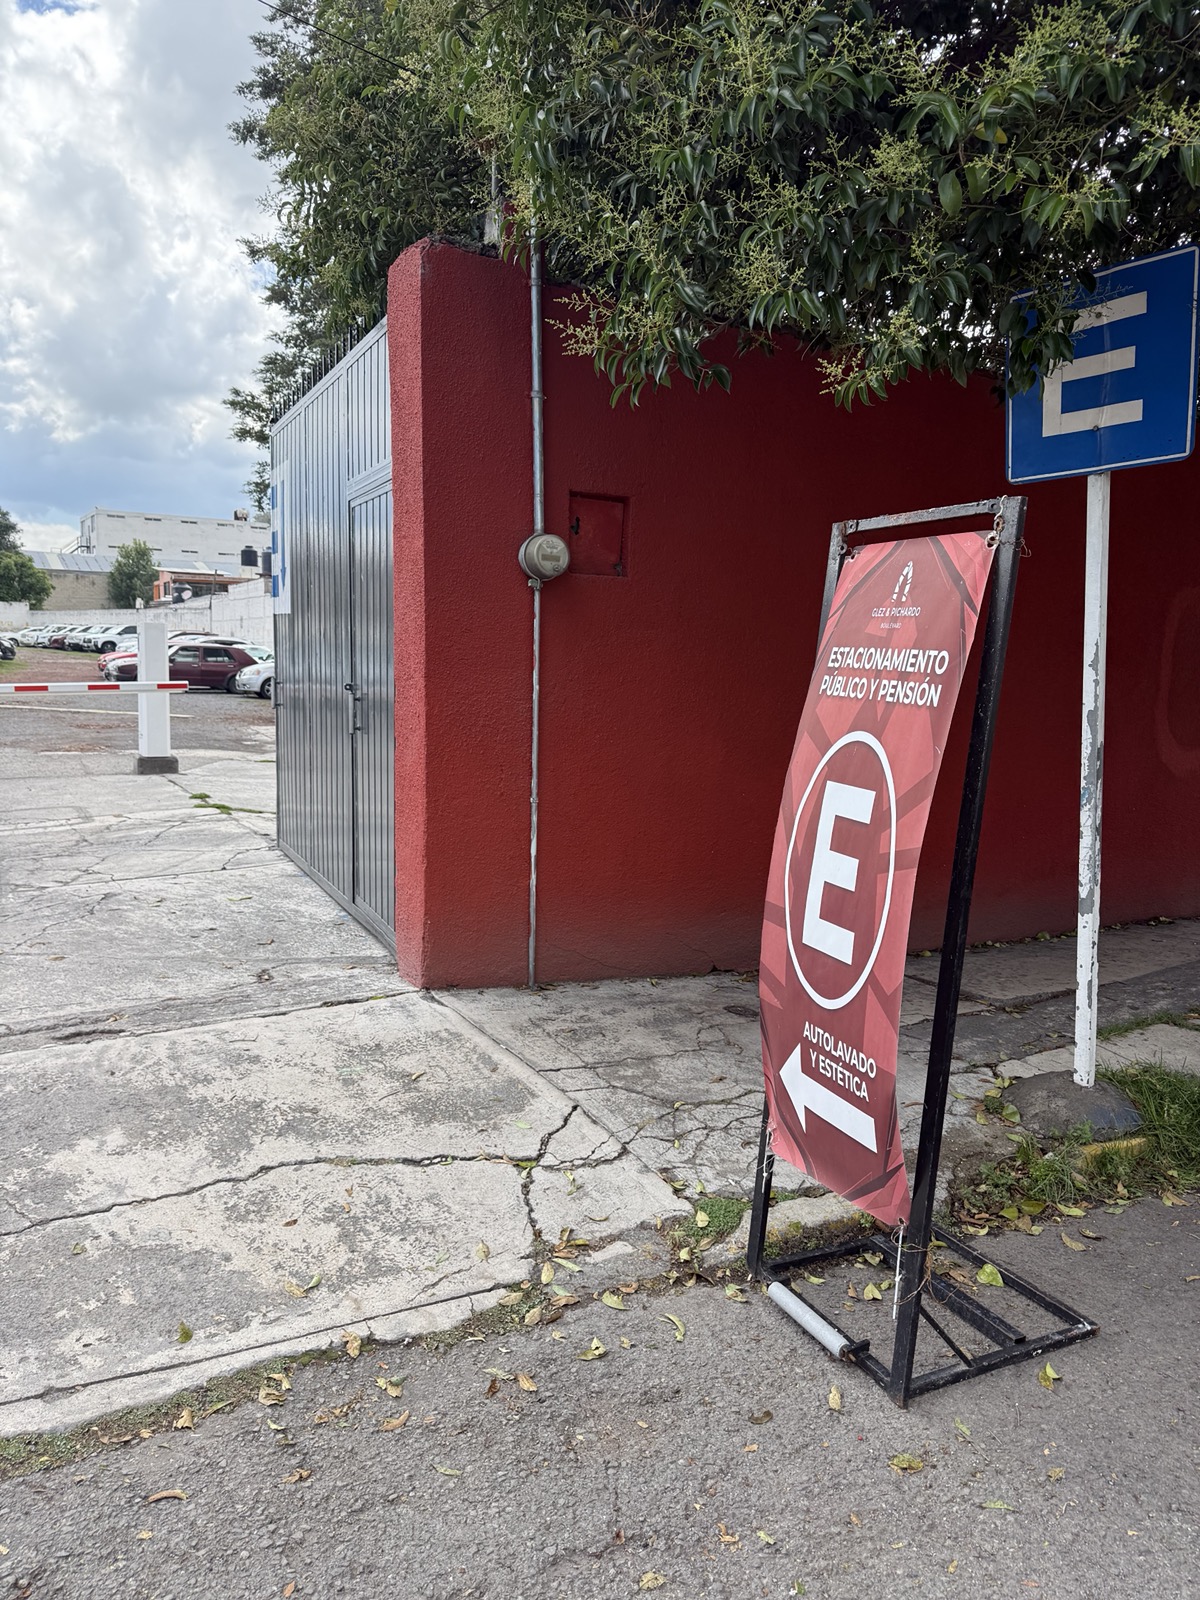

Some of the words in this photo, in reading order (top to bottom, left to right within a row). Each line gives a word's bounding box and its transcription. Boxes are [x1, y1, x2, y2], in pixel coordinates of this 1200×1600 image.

[1042, 290, 1148, 438] E
[871, 607, 886, 617] GLEZ
[890, 606, 921, 617] PICHARDO
[827, 646, 950, 675] ESTACIONAMIENTO
[819, 671, 868, 699] PÚBLICO
[868, 679, 880, 700] Y
[877, 677, 942, 708] PENSIÓN
[802, 780, 876, 966] E
[803, 1021, 877, 1079] AUTOLAVADO
[809, 1048, 817, 1068] Y
[819, 1055, 869, 1103] ESTÉTICA
